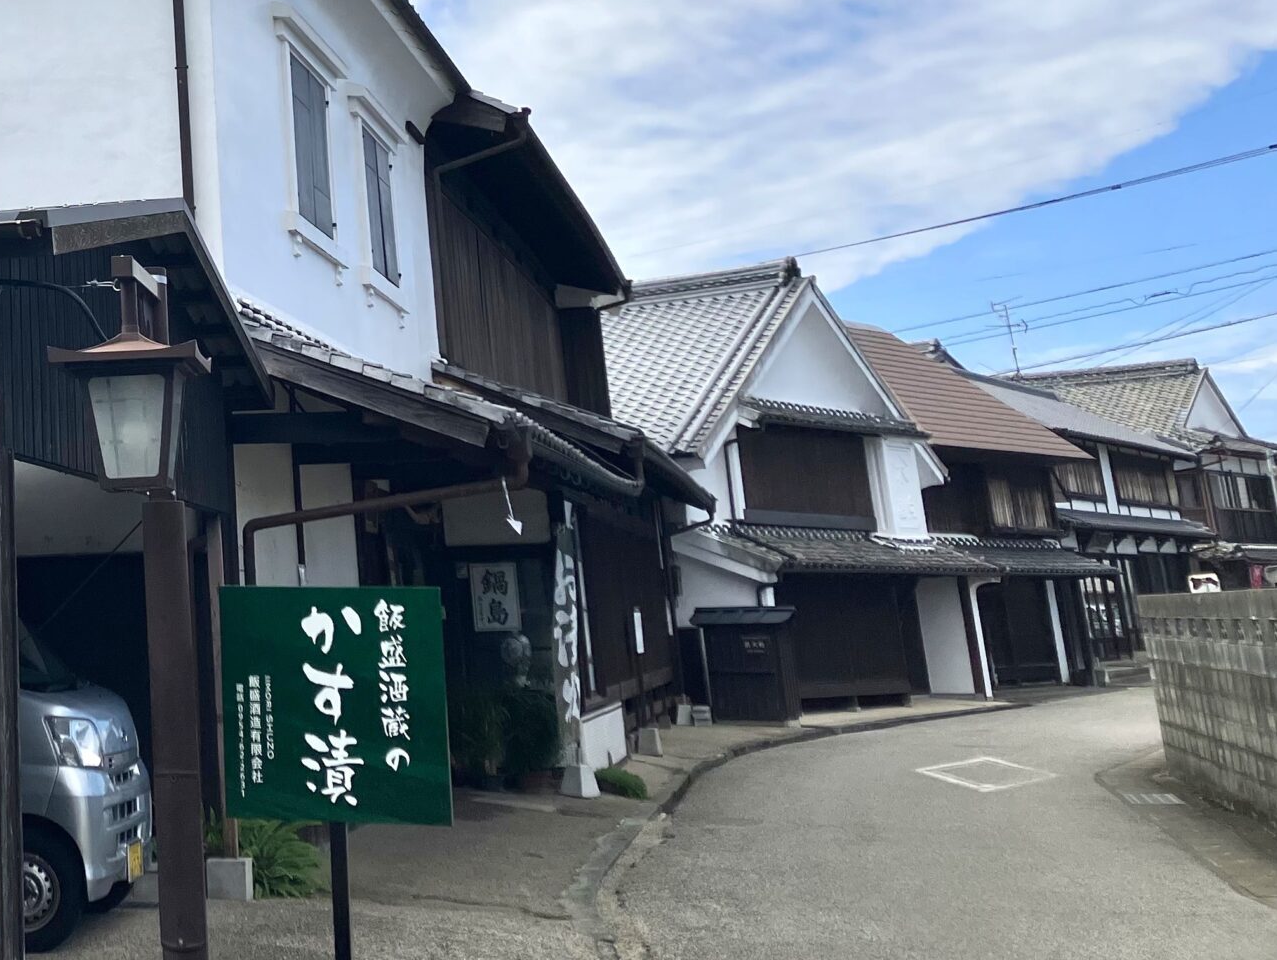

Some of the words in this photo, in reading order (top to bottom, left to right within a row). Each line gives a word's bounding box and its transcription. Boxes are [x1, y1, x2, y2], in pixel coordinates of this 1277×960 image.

[481, 568, 509, 625] 鍋島
[248, 674, 264, 784] 飯盛酒造有限会社
[266, 714, 275, 760] SHUZO
[300, 606, 365, 807] かす漬
[373, 598, 411, 772] 飯盛酒蔵の
